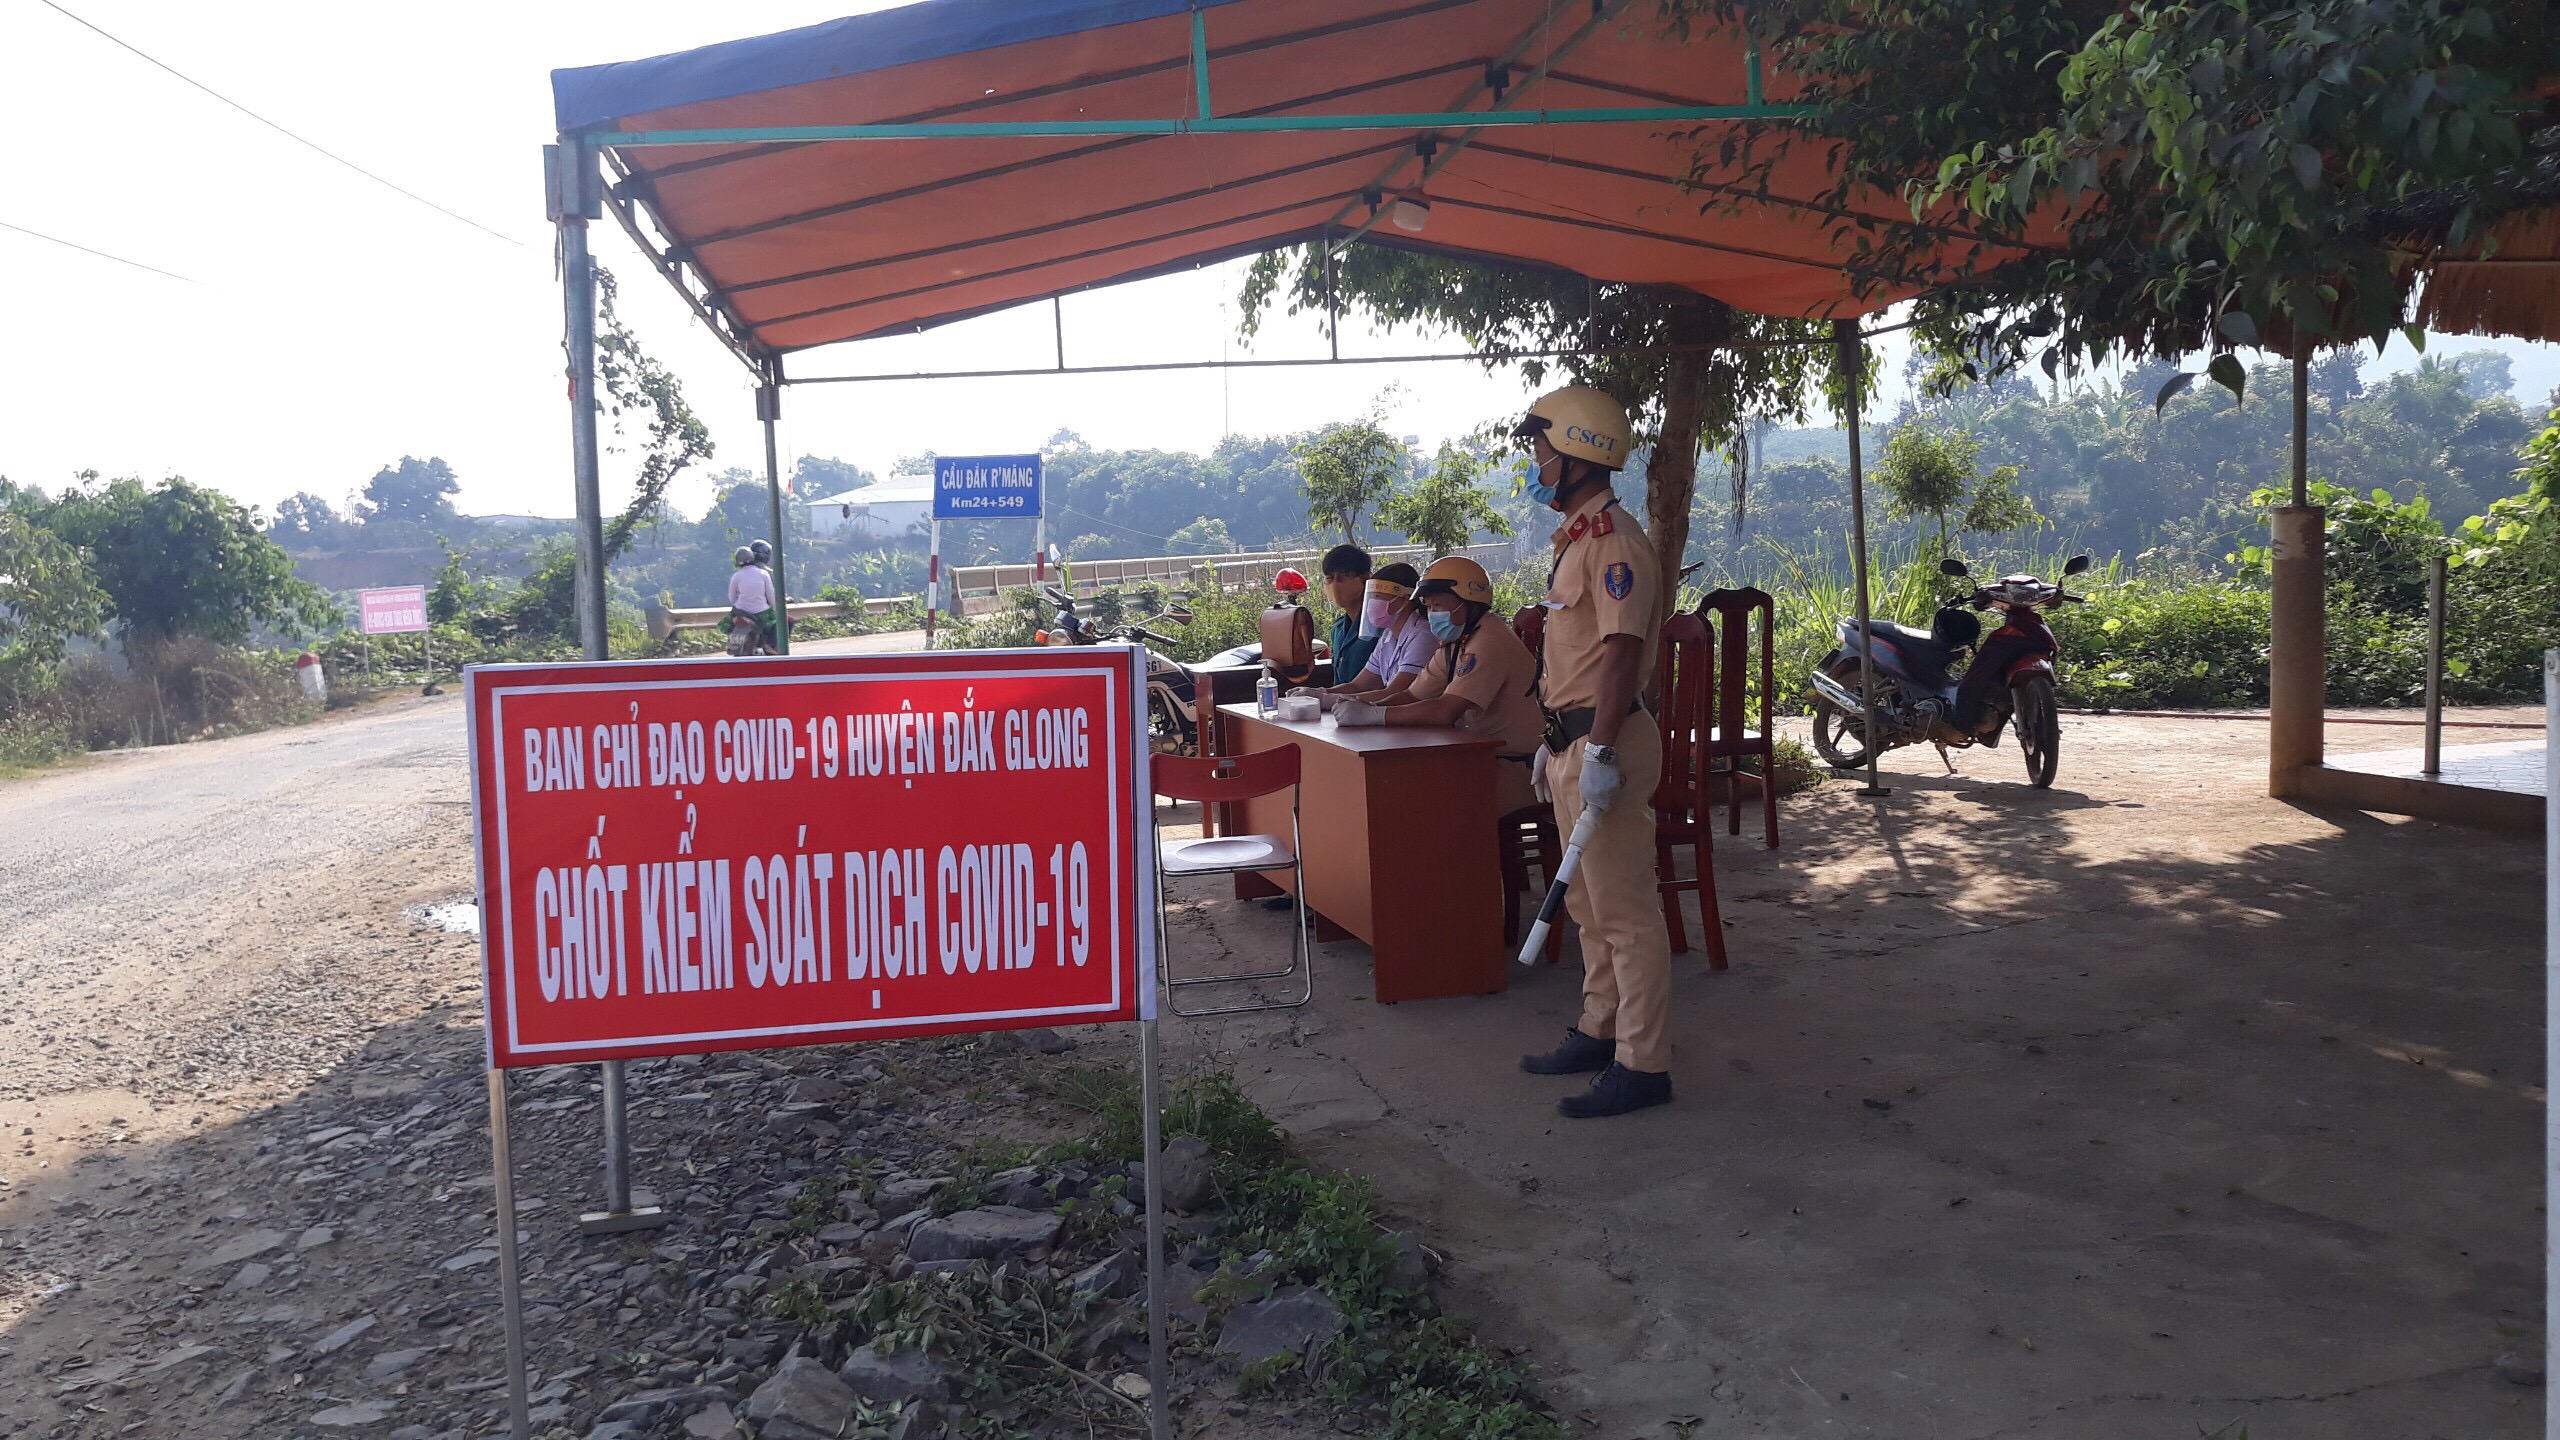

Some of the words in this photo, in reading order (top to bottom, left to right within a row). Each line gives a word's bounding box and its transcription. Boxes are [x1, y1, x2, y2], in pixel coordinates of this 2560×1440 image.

[1566, 425, 1617, 452] CSGT
[942, 462, 963, 490] CẦU
[966, 462, 987, 489] ĐẮK
[991, 464, 1033, 488] R'MĂNG
[951, 496, 1024, 508] Km24+549
[523, 725, 585, 793] BAN
[592, 701, 641, 790] CHỈ
[648, 720, 706, 800] ĐẠO
[713, 714, 839, 784] COVID-19
[846, 698, 936, 789] HUYỆN
[942, 687, 997, 774] ĐẮK
[1004, 706, 1090, 771] GLONG
[535, 815, 628, 1003] CHỐT
[638, 802, 734, 996] KIỂM
[744, 824, 834, 989] SOÁT
[844, 847, 927, 1010] DỊCH
[937, 840, 1090, 977] COVID-19
